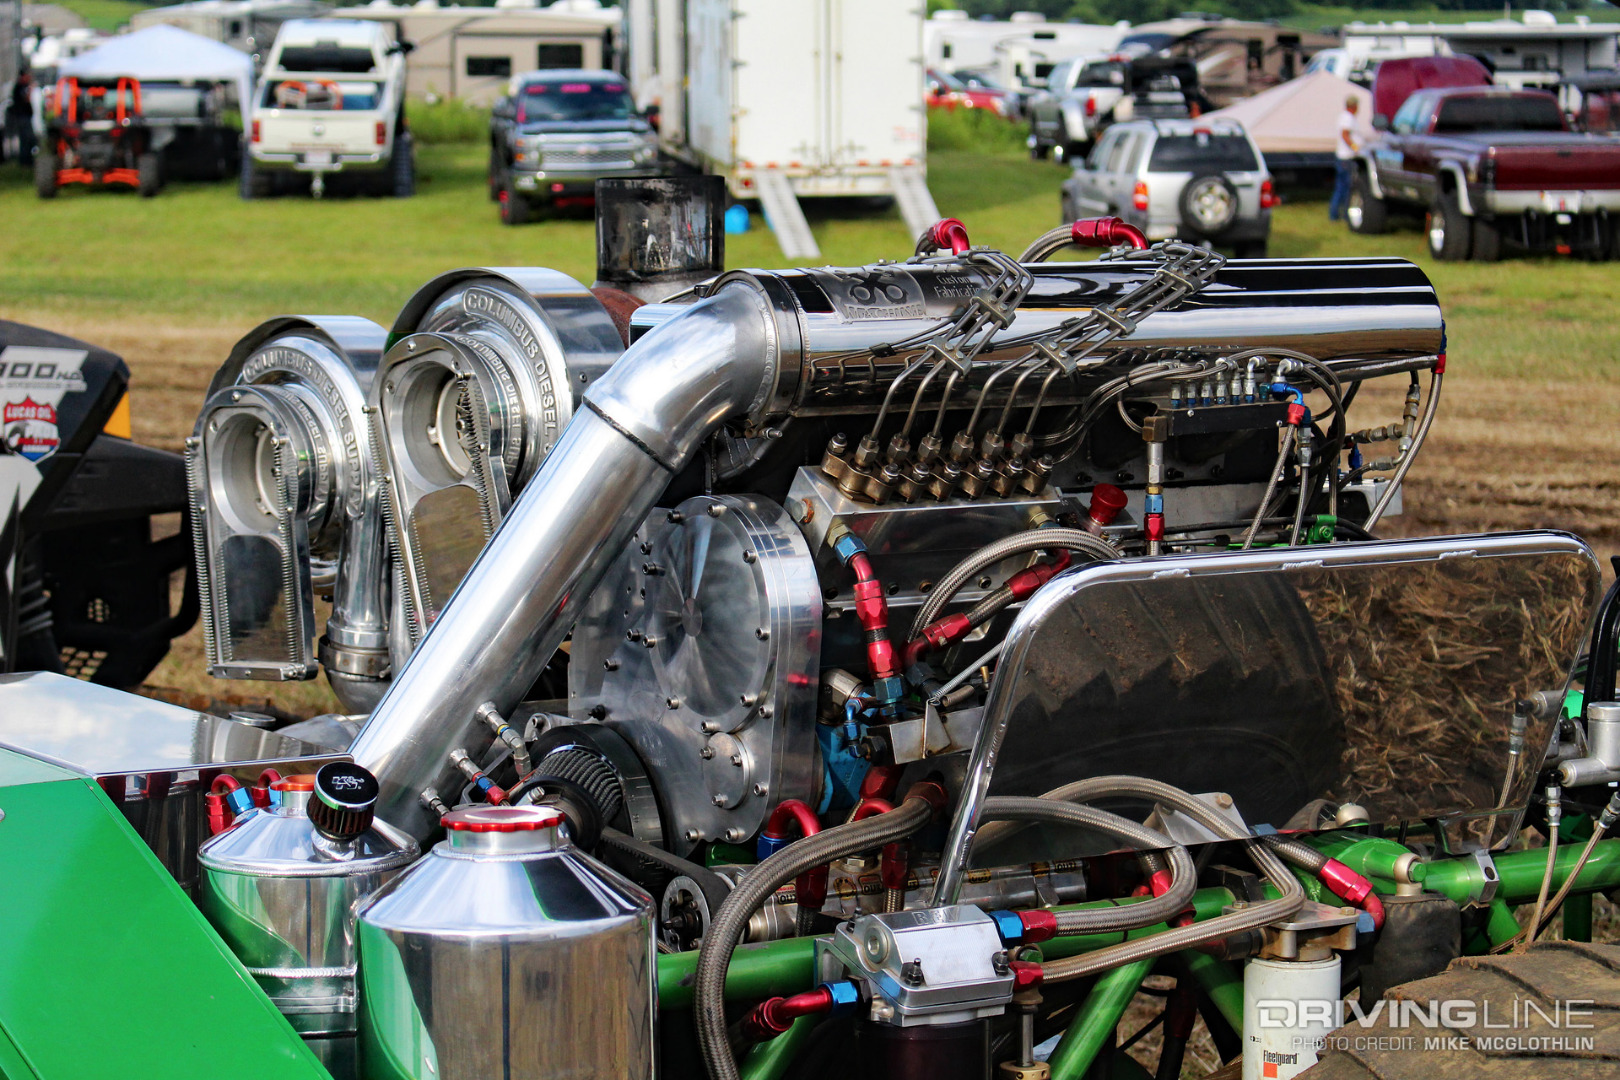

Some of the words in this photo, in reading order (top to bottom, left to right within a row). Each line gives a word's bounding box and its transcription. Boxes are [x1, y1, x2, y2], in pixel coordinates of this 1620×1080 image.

[936, 275, 971, 284] Custom
[934, 284, 980, 298] Fabricati
[466, 293, 539, 359] COLUMBUS
[535, 360, 556, 431] DIESEL
[6, 405, 37, 418] LUCAS
[36, 406, 52, 419] OIL
[244, 350, 313, 378] COLUMBUS
[314, 369, 349, 429] DIESEL
[343, 431, 362, 516] SUPPLY
[1263, 1049, 1298, 1066] Fleetguard
